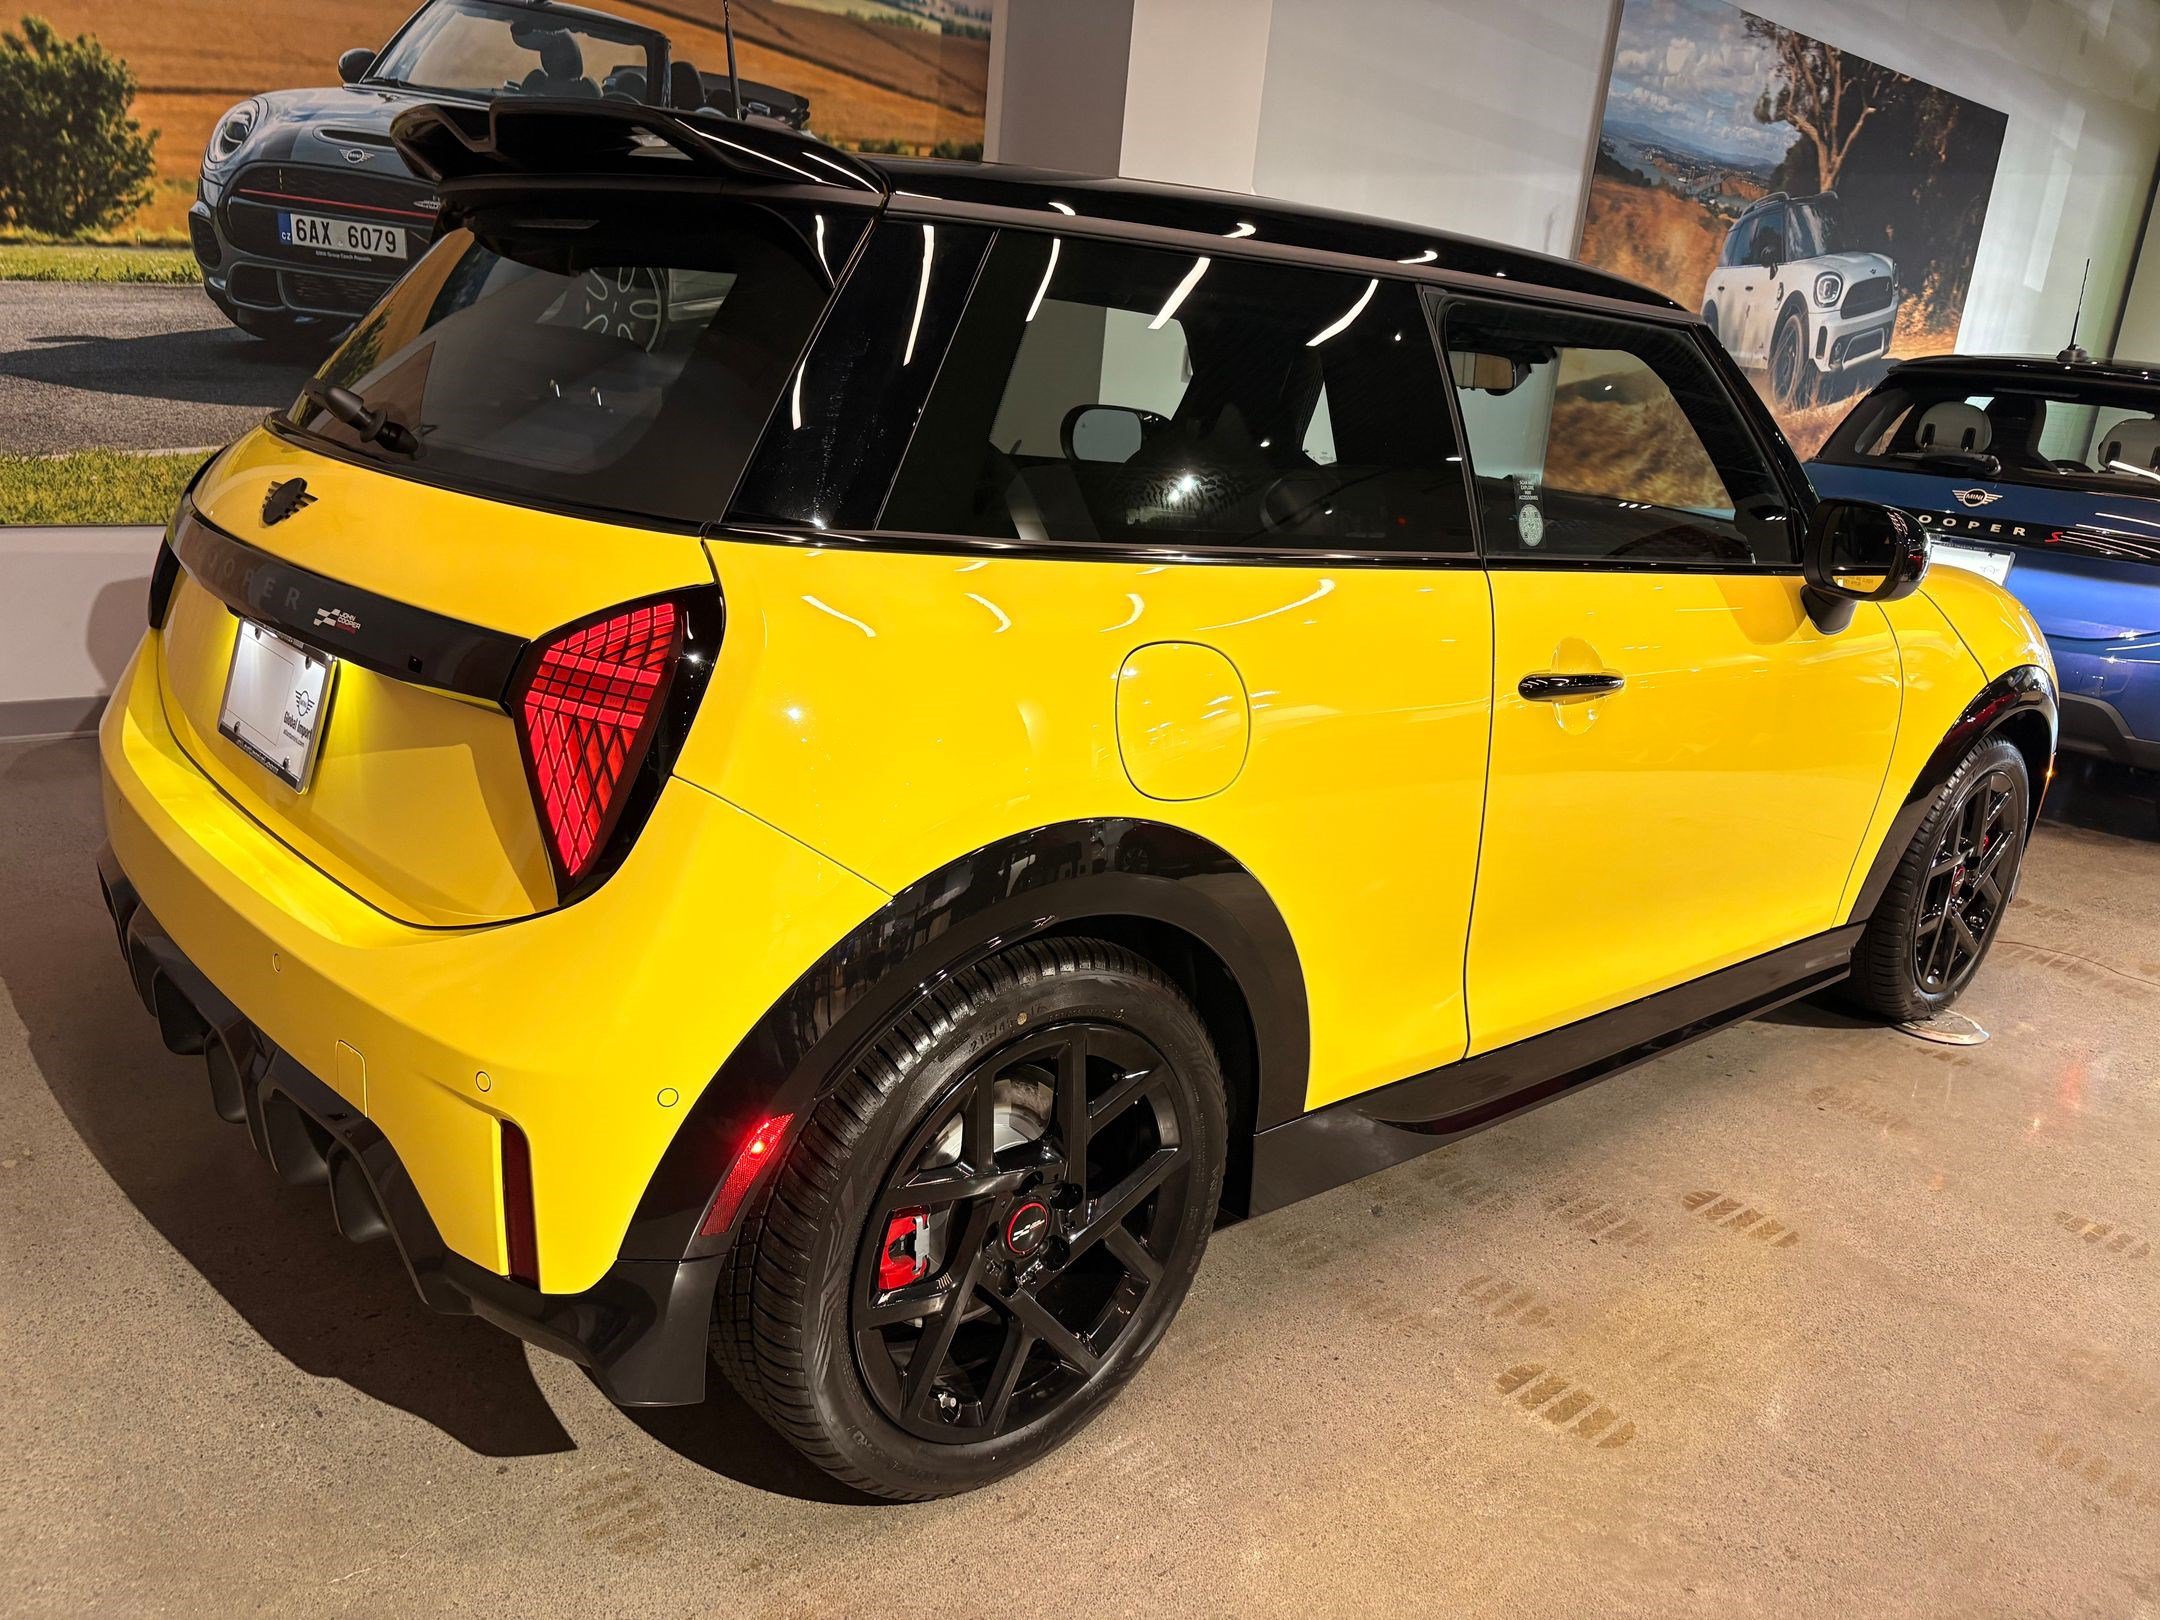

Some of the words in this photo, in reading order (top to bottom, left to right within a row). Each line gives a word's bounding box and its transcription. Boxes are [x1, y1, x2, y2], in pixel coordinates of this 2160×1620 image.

[296, 218, 332, 246] 6AX
[347, 225, 396, 253] 6079
[1965, 493, 1985, 501] MINI
[1918, 514, 2026, 538] OOPER
[2045, 531, 2063, 543] S
[337, 616, 361, 630] COOPER
